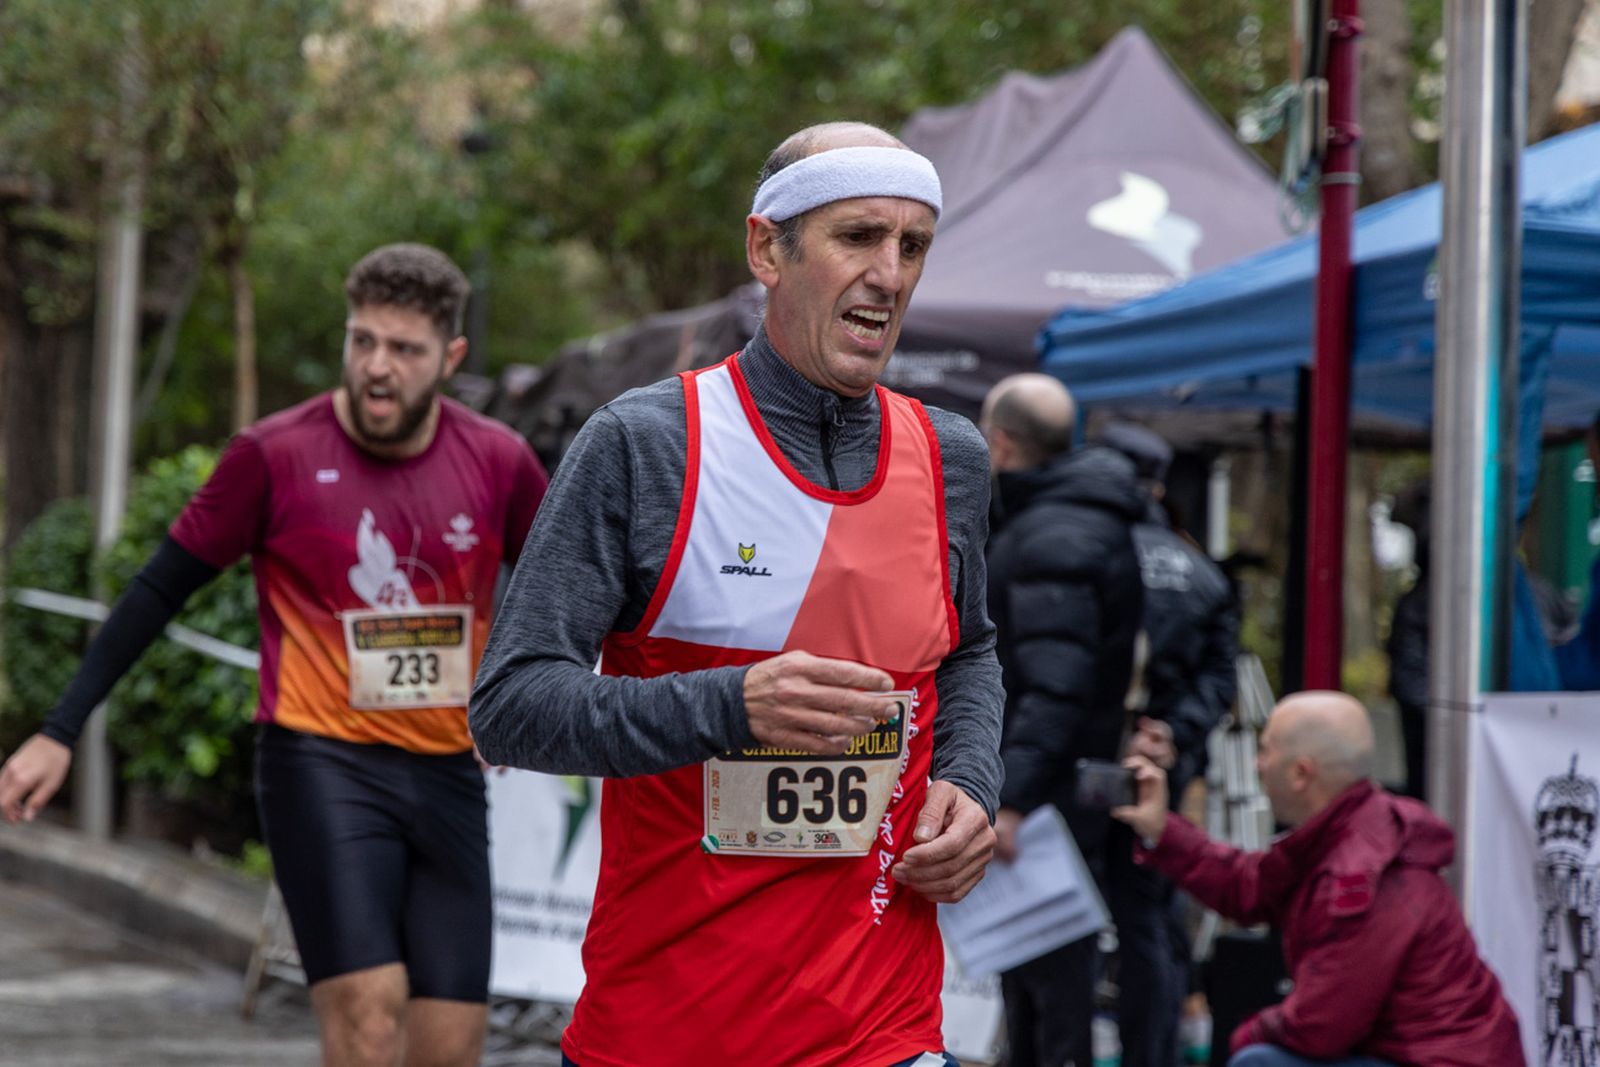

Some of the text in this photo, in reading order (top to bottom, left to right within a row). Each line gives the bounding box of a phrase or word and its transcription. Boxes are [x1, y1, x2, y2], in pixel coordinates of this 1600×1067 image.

[720, 565, 772, 577] SPALL
[387, 653, 439, 686] 233
[842, 731, 899, 757] OPULAR
[766, 766, 868, 825] 636
